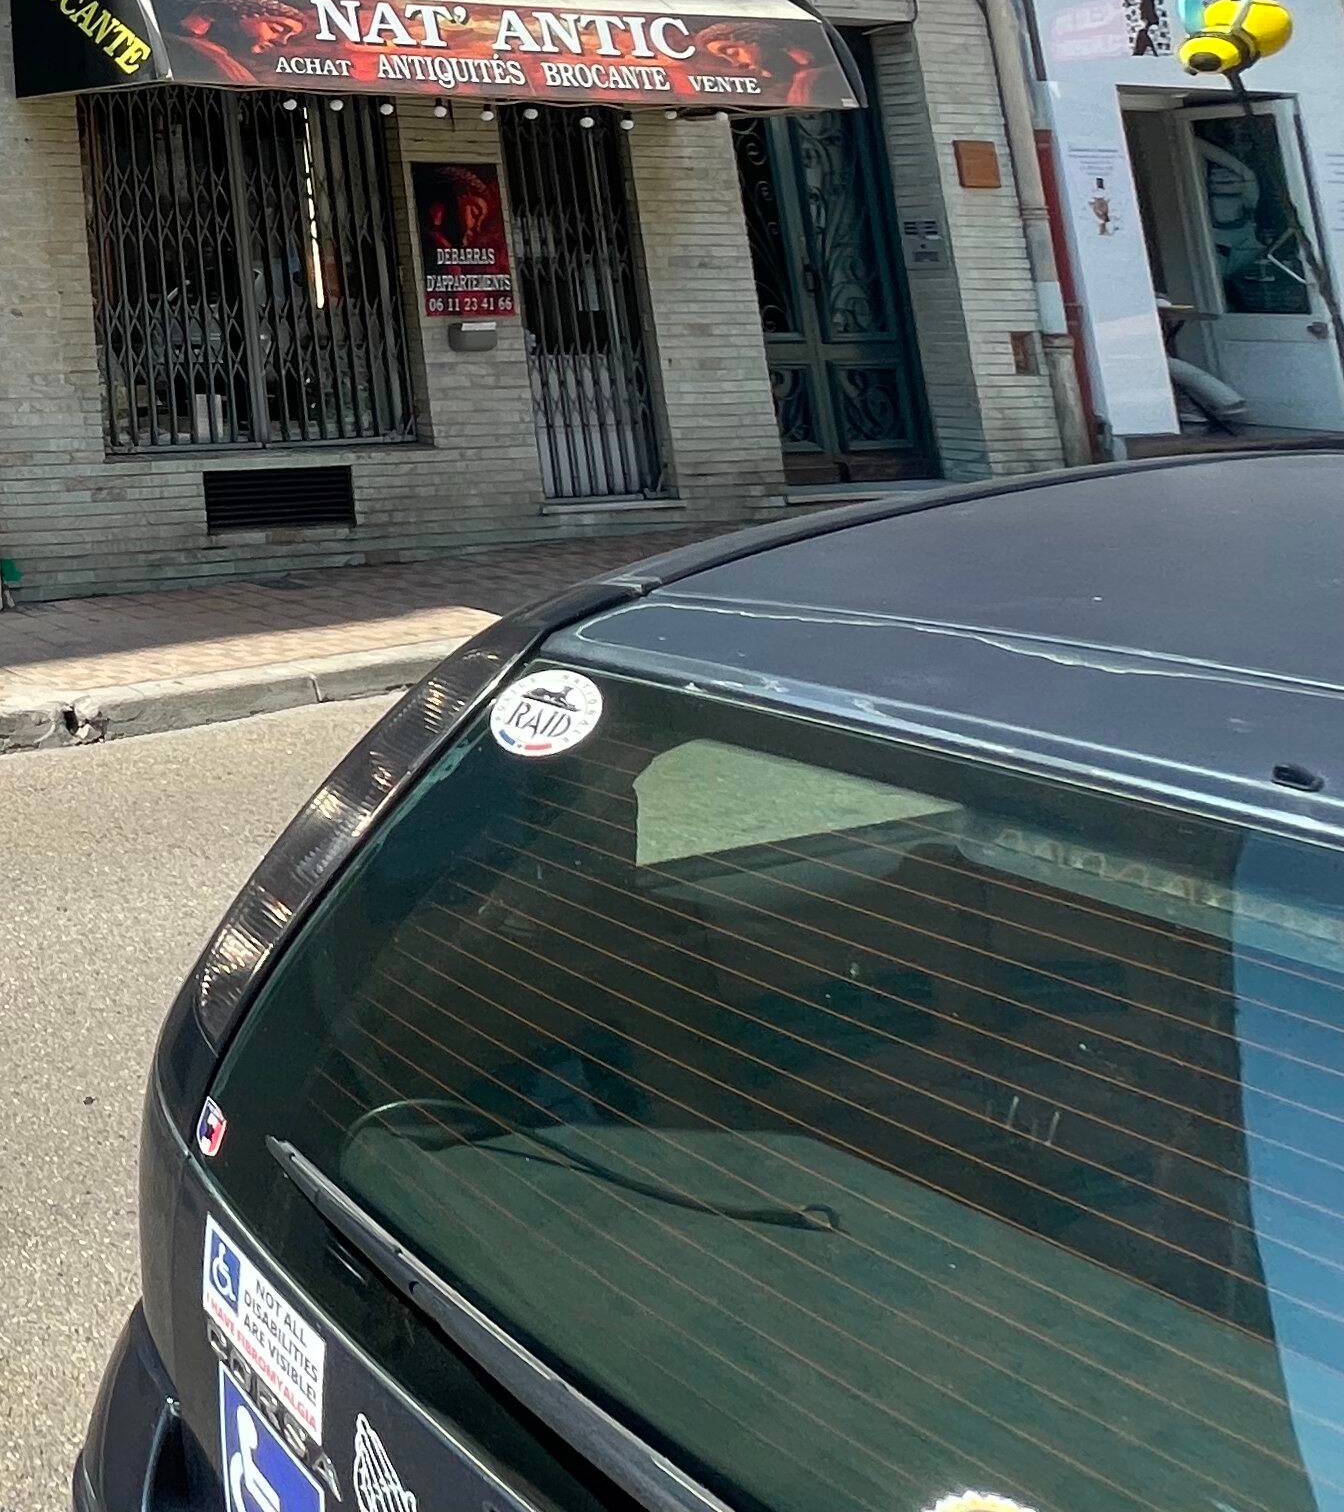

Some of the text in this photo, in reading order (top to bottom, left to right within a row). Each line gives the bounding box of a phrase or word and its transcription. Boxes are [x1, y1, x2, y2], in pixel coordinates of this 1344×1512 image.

[492, 9, 696, 60] ANTIC
[275, 53, 761, 94] ACHAT ANTIQUITÉS BROCANTE VENTE
[428, 296, 512, 312] 06 11 23 41 66
[505, 700, 572, 740] RAID
[244, 1313, 265, 1348] ARE
[244, 1289, 318, 1383] DISABILITIES
[256, 1279, 308, 1348] NOT ALL
[211, 1298, 235, 1337] HAVE
[237, 1329, 317, 1433] FIBROMYALGIA
